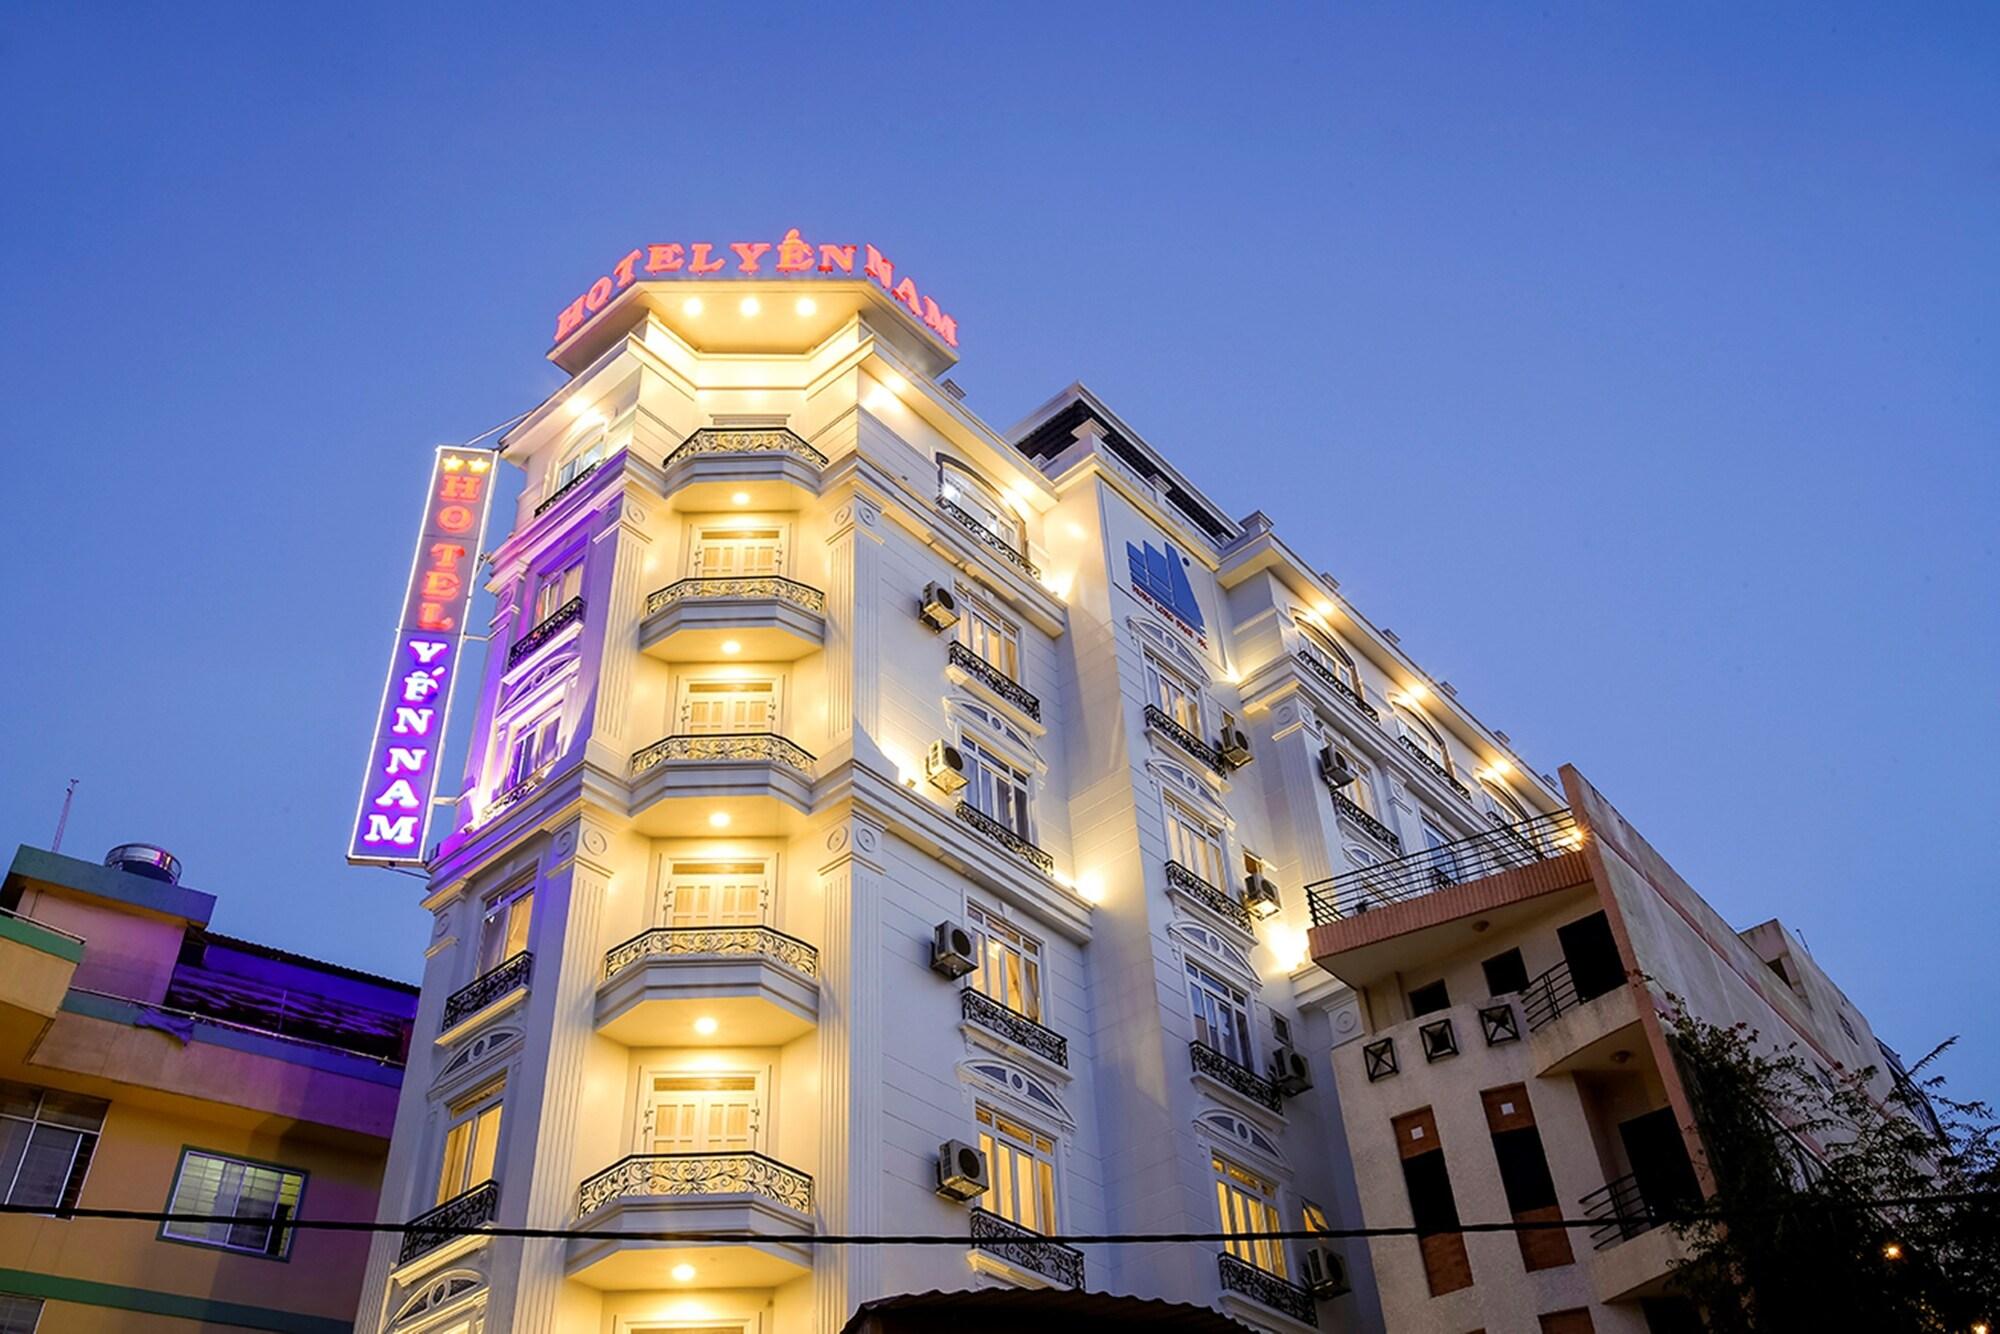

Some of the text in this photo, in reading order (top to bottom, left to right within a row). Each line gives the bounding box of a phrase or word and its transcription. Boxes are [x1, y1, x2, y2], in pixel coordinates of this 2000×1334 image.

[553, 242, 725, 342] HOTEL
[864, 243, 960, 347] NAM
[416, 474, 480, 630] HOTEL
[363, 747, 427, 844] NAM
